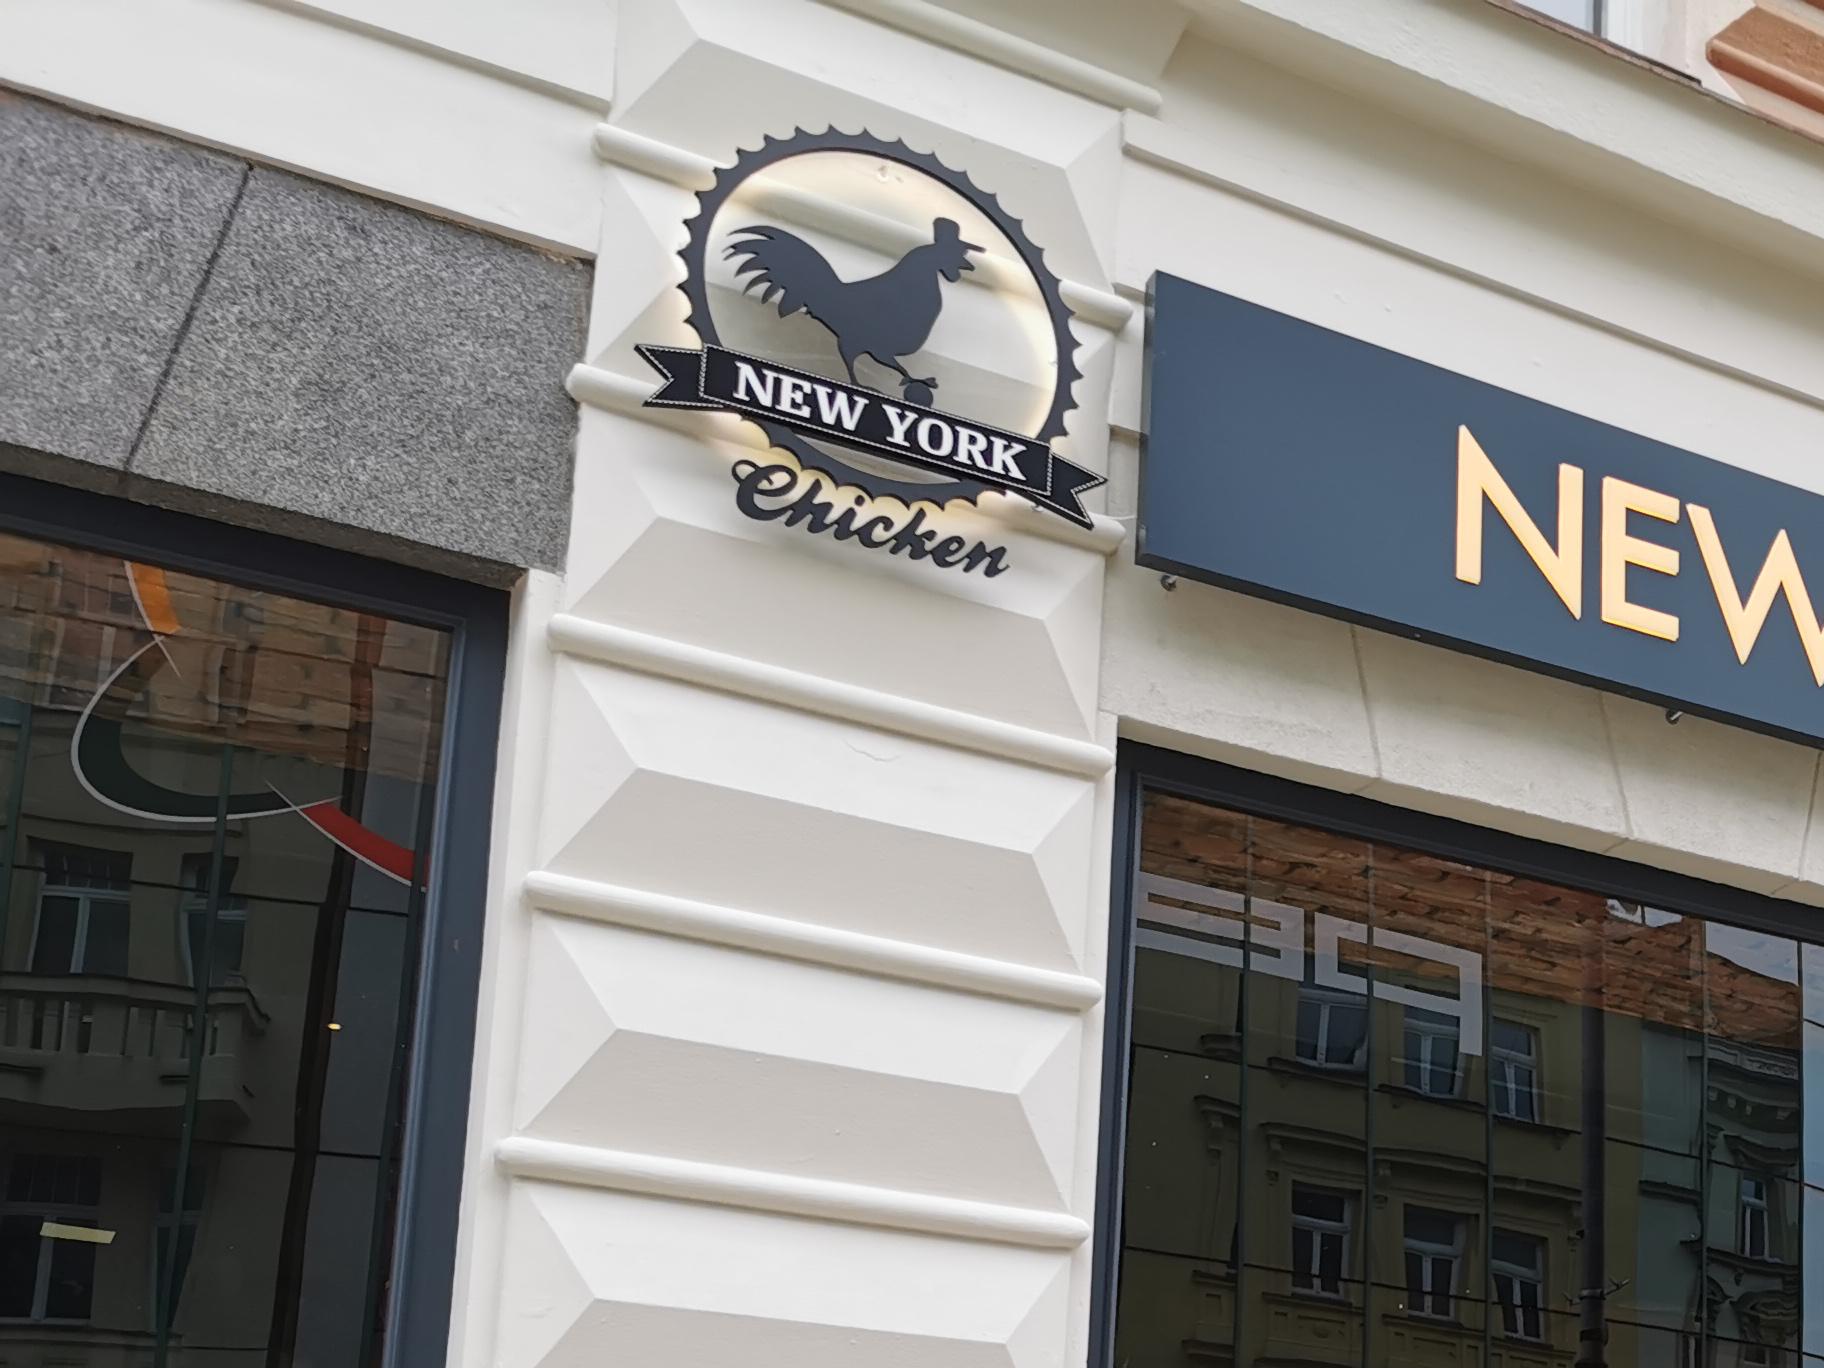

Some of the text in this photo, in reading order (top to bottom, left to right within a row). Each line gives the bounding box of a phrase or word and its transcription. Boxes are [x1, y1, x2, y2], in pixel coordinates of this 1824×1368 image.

[732, 361, 1029, 482] NEW YORK
[731, 457, 1010, 578] Chicken
